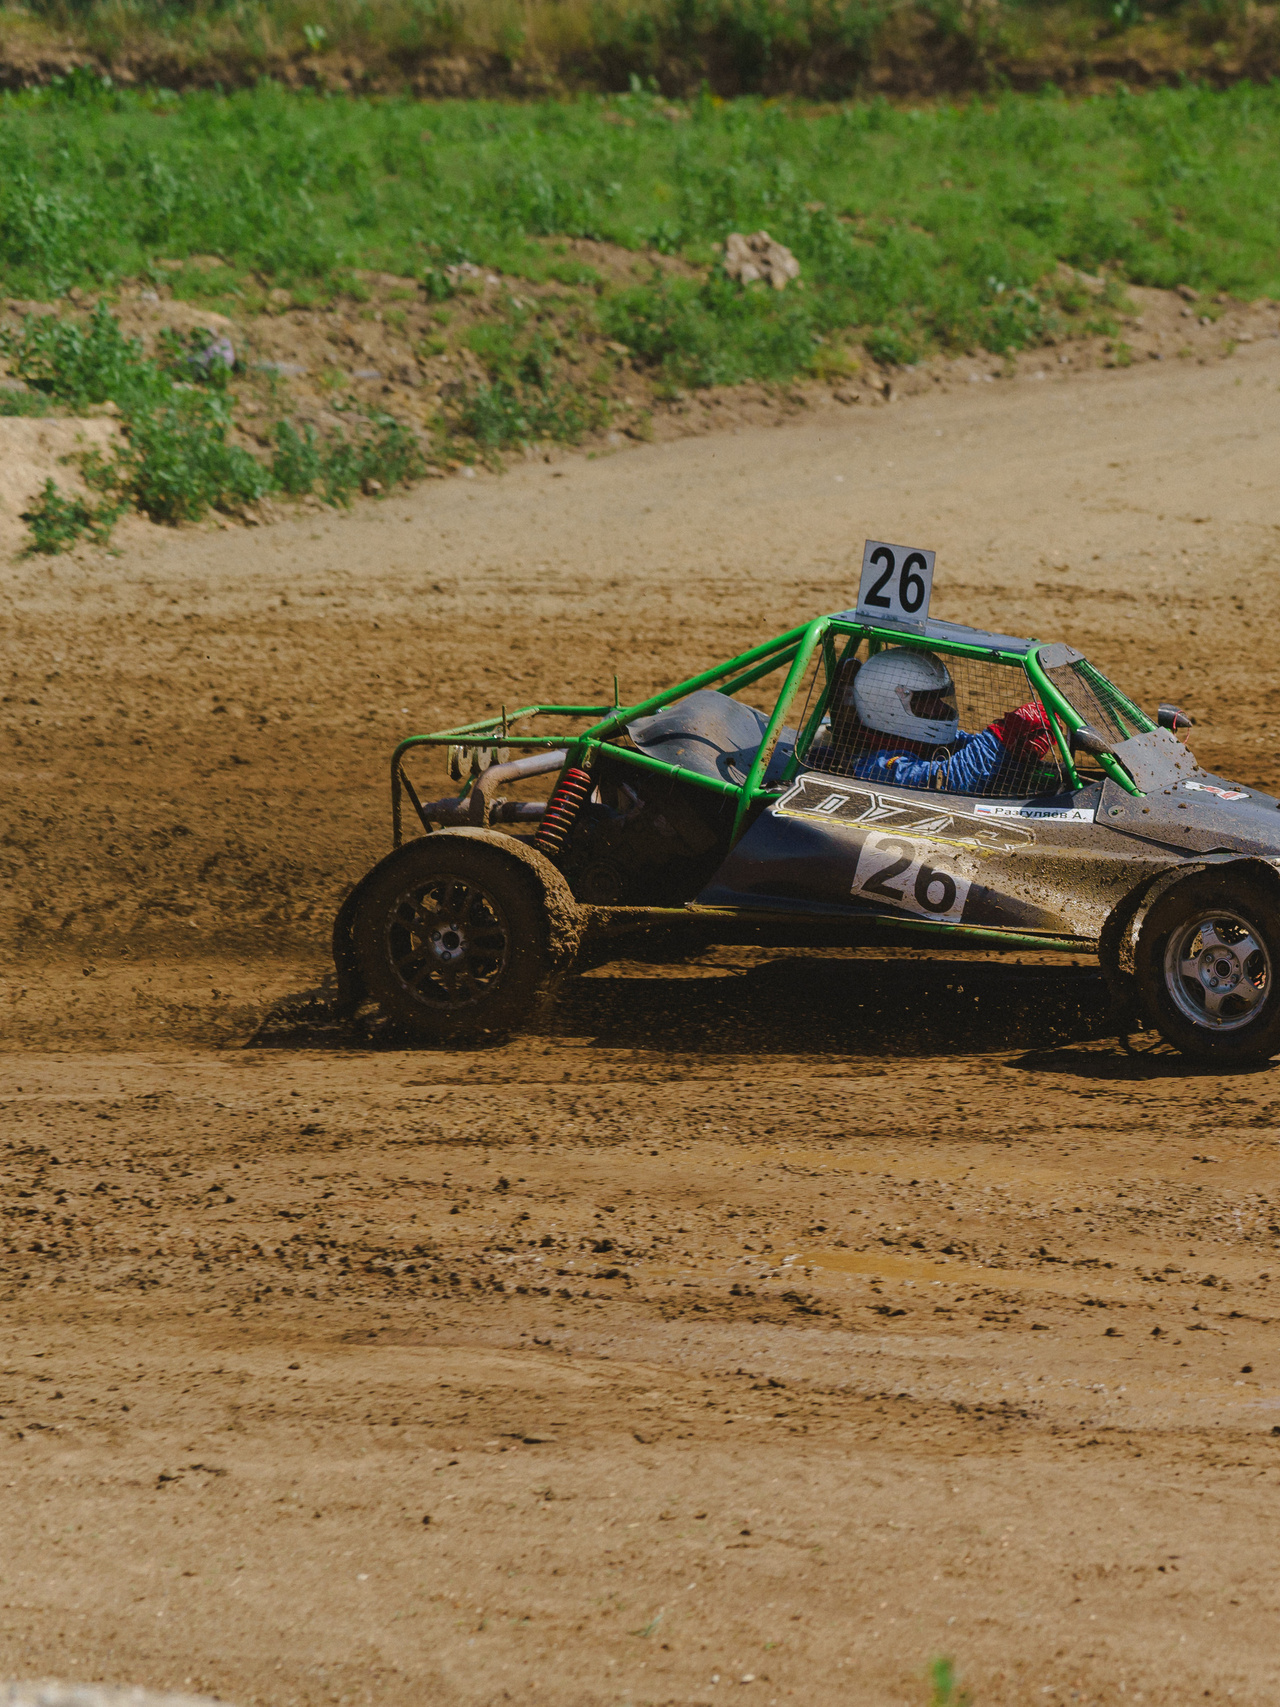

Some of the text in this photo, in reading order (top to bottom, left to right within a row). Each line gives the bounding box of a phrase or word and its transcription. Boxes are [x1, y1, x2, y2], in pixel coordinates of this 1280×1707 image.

[864, 547, 927, 613] 26
[994, 807, 1068, 819] Разгуляев
[861, 838, 957, 913] 26
